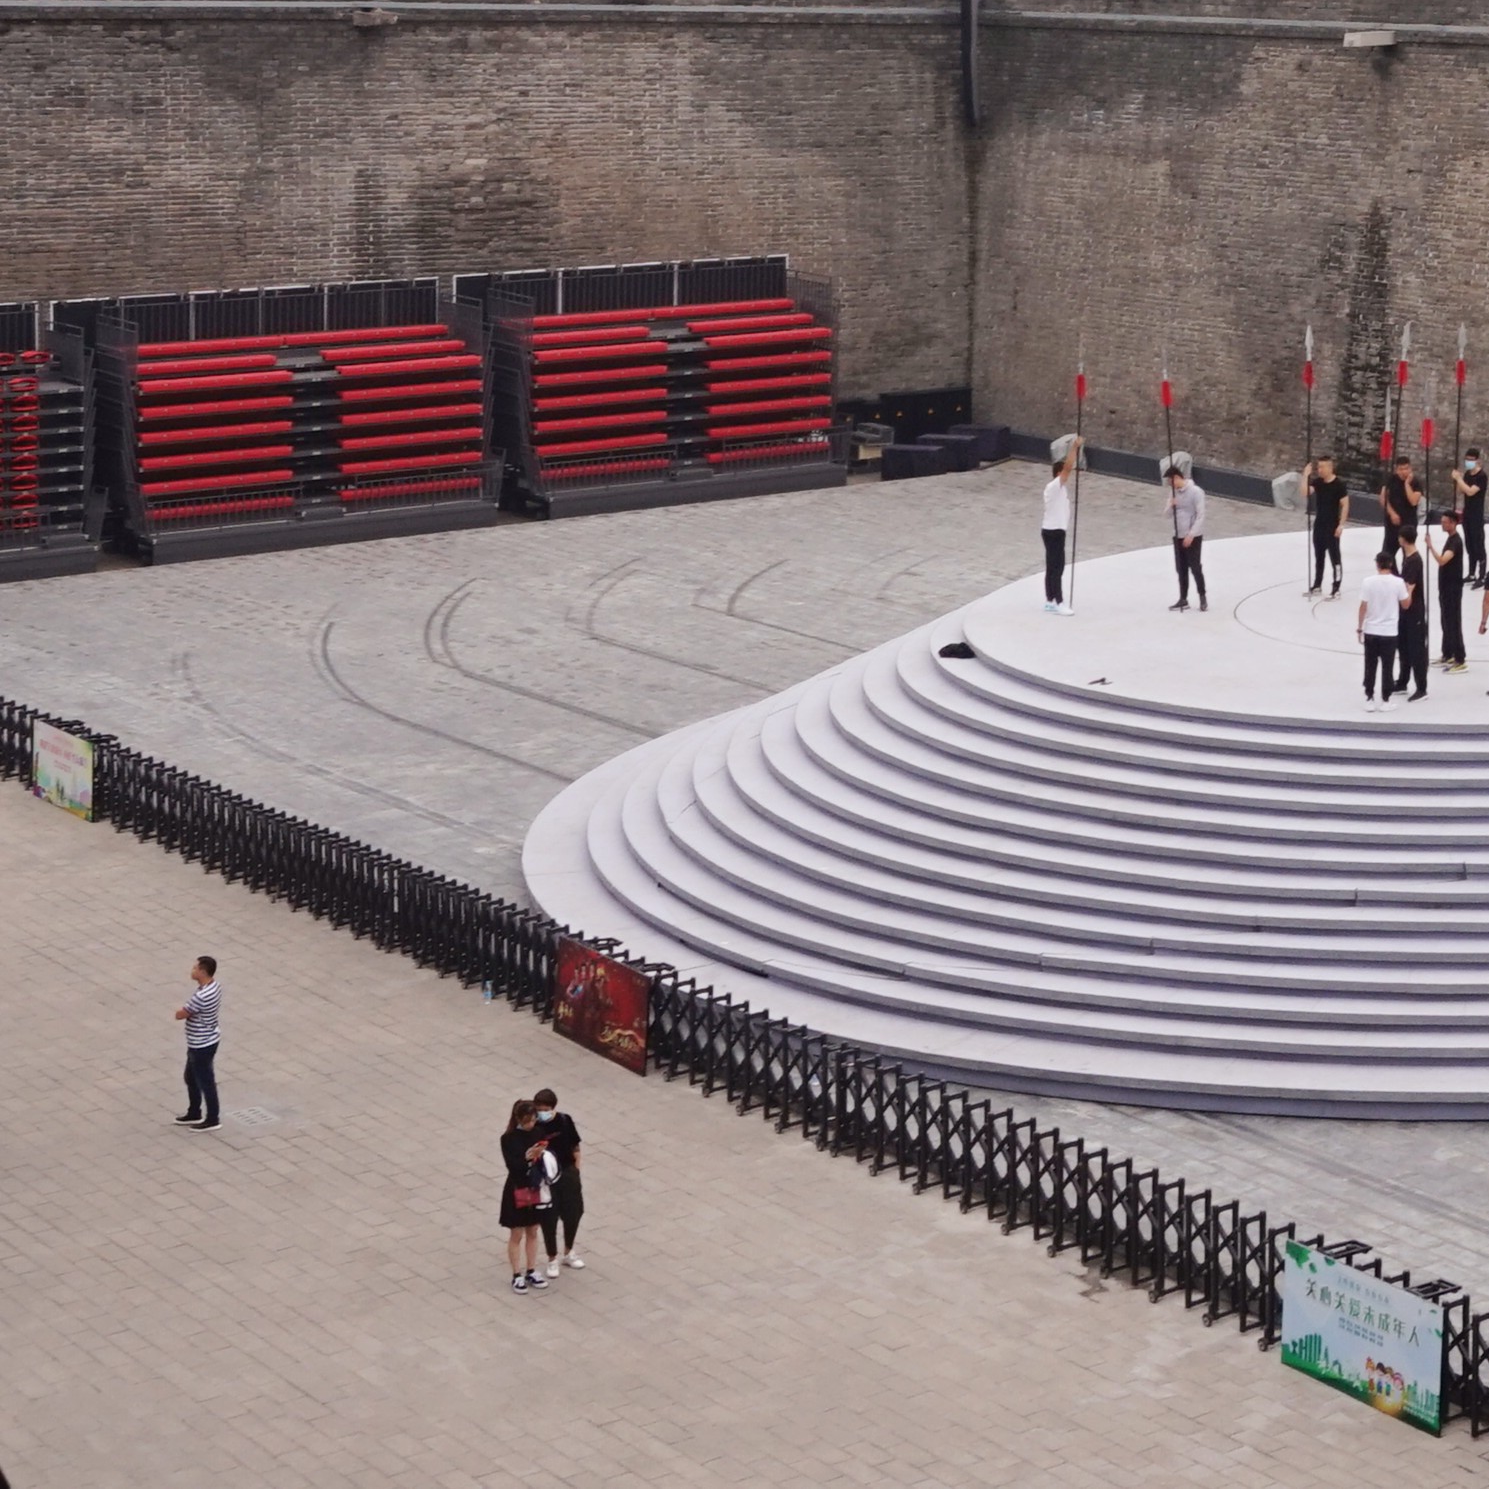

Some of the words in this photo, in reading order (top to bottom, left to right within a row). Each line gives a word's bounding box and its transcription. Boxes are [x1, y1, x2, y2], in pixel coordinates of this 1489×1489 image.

[1306, 1278, 1420, 1347] 关心关爱未成年人
